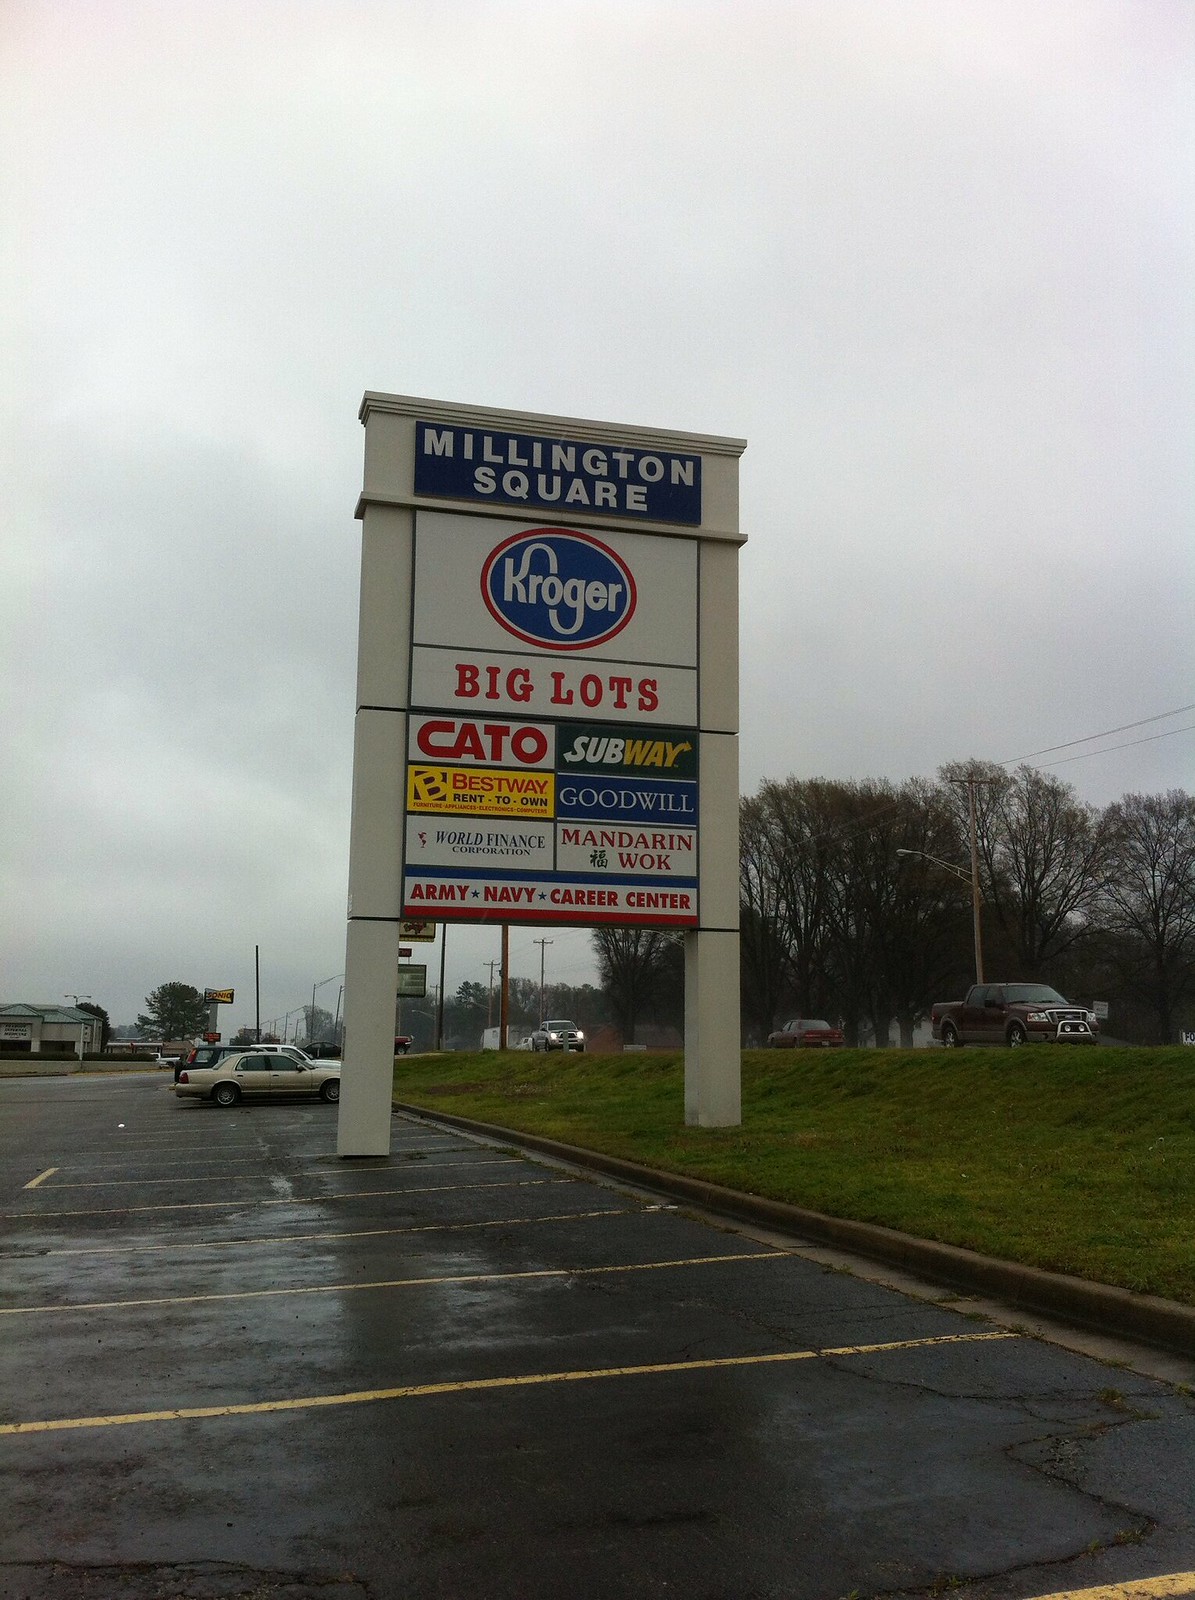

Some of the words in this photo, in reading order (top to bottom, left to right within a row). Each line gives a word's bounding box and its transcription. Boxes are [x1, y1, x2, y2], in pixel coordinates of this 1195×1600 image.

[424, 428, 694, 487] MILLINGTON
[473, 466, 648, 511] SQUARE
[503, 543, 622, 635] Kroger
[455, 664, 534, 702] BIG
[550, 672, 659, 711] LOTS
[417, 720, 548, 764] CATO
[563, 735, 692, 768] SUBWAY
[452, 773, 548, 795] BESTWAY
[453, 793, 485, 803] RENT
[495, 795, 511, 805] TO
[520, 797, 548, 807] OWN
[559, 787, 694, 812] GOODWILL
[435, 830, 483, 846] WORLD
[487, 833, 546, 849] FINANCE
[452, 845, 531, 856] CORPORATION
[561, 828, 693, 851] MANDARIN
[589, 849, 608, 869] 福
[618, 852, 672, 870] WOK
[410, 884, 470, 901] ARMY
[484, 886, 536, 903] NAVY
[550, 889, 619, 907] CAREER
[625, 891, 691, 910] CENTER
